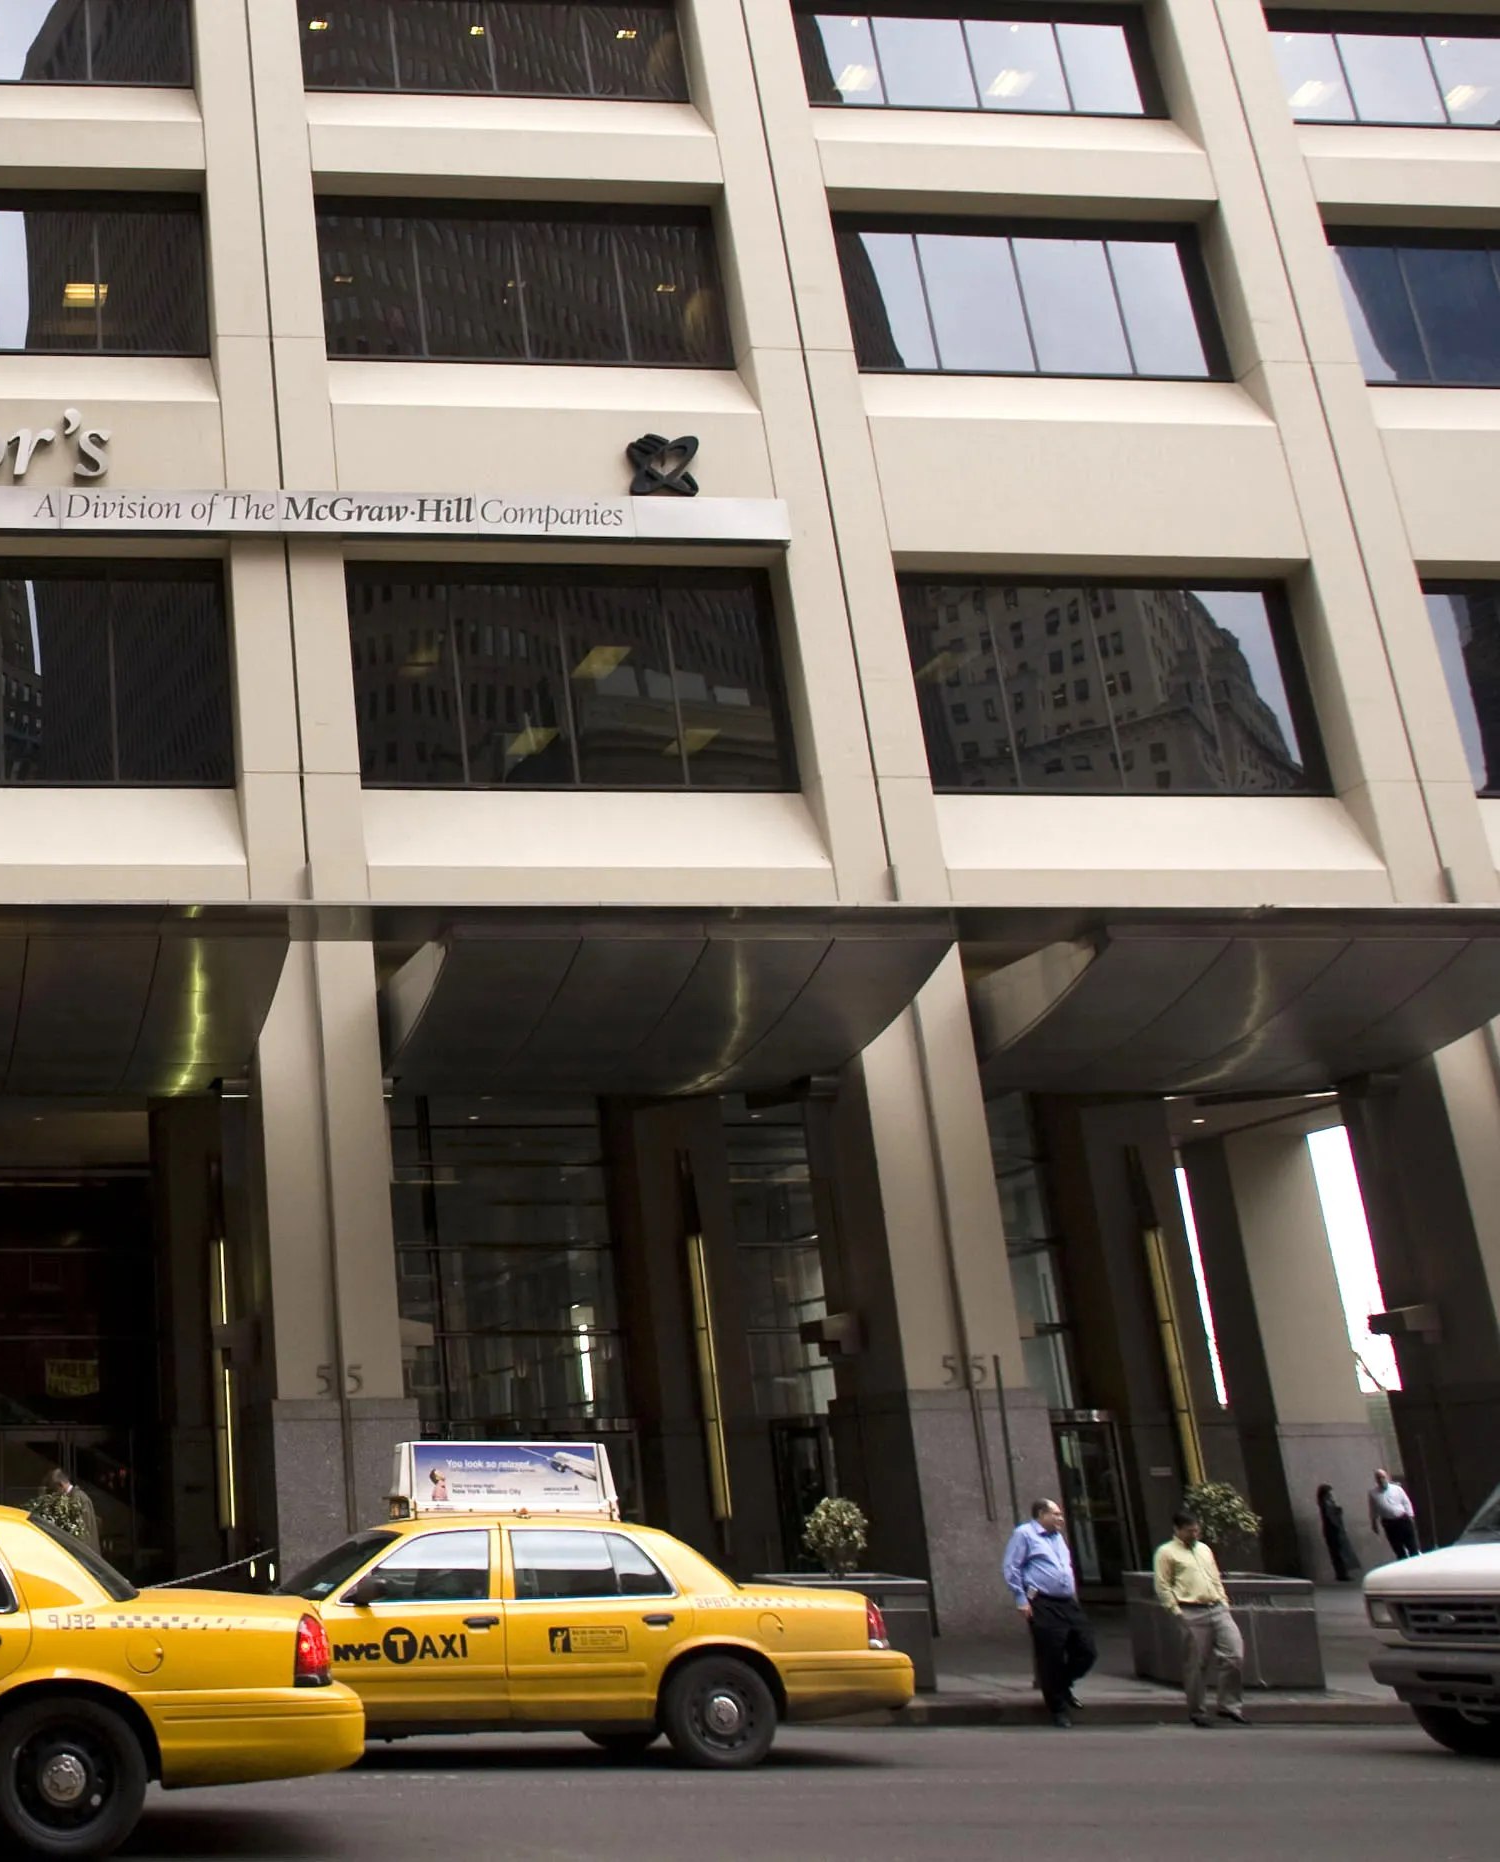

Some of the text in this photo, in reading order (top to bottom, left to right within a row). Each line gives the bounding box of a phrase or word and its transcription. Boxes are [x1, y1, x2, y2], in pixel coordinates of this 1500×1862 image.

[33, 494, 57, 519] A
[65, 493, 182, 519] Division
[191, 493, 220, 527] of
[223, 495, 276, 521] The
[481, 499, 625, 532] Companies
[445, 1459, 463, 1468] You
[465, 1459, 484, 1468] look
[333, 1626, 468, 1665] NYC TAXI
